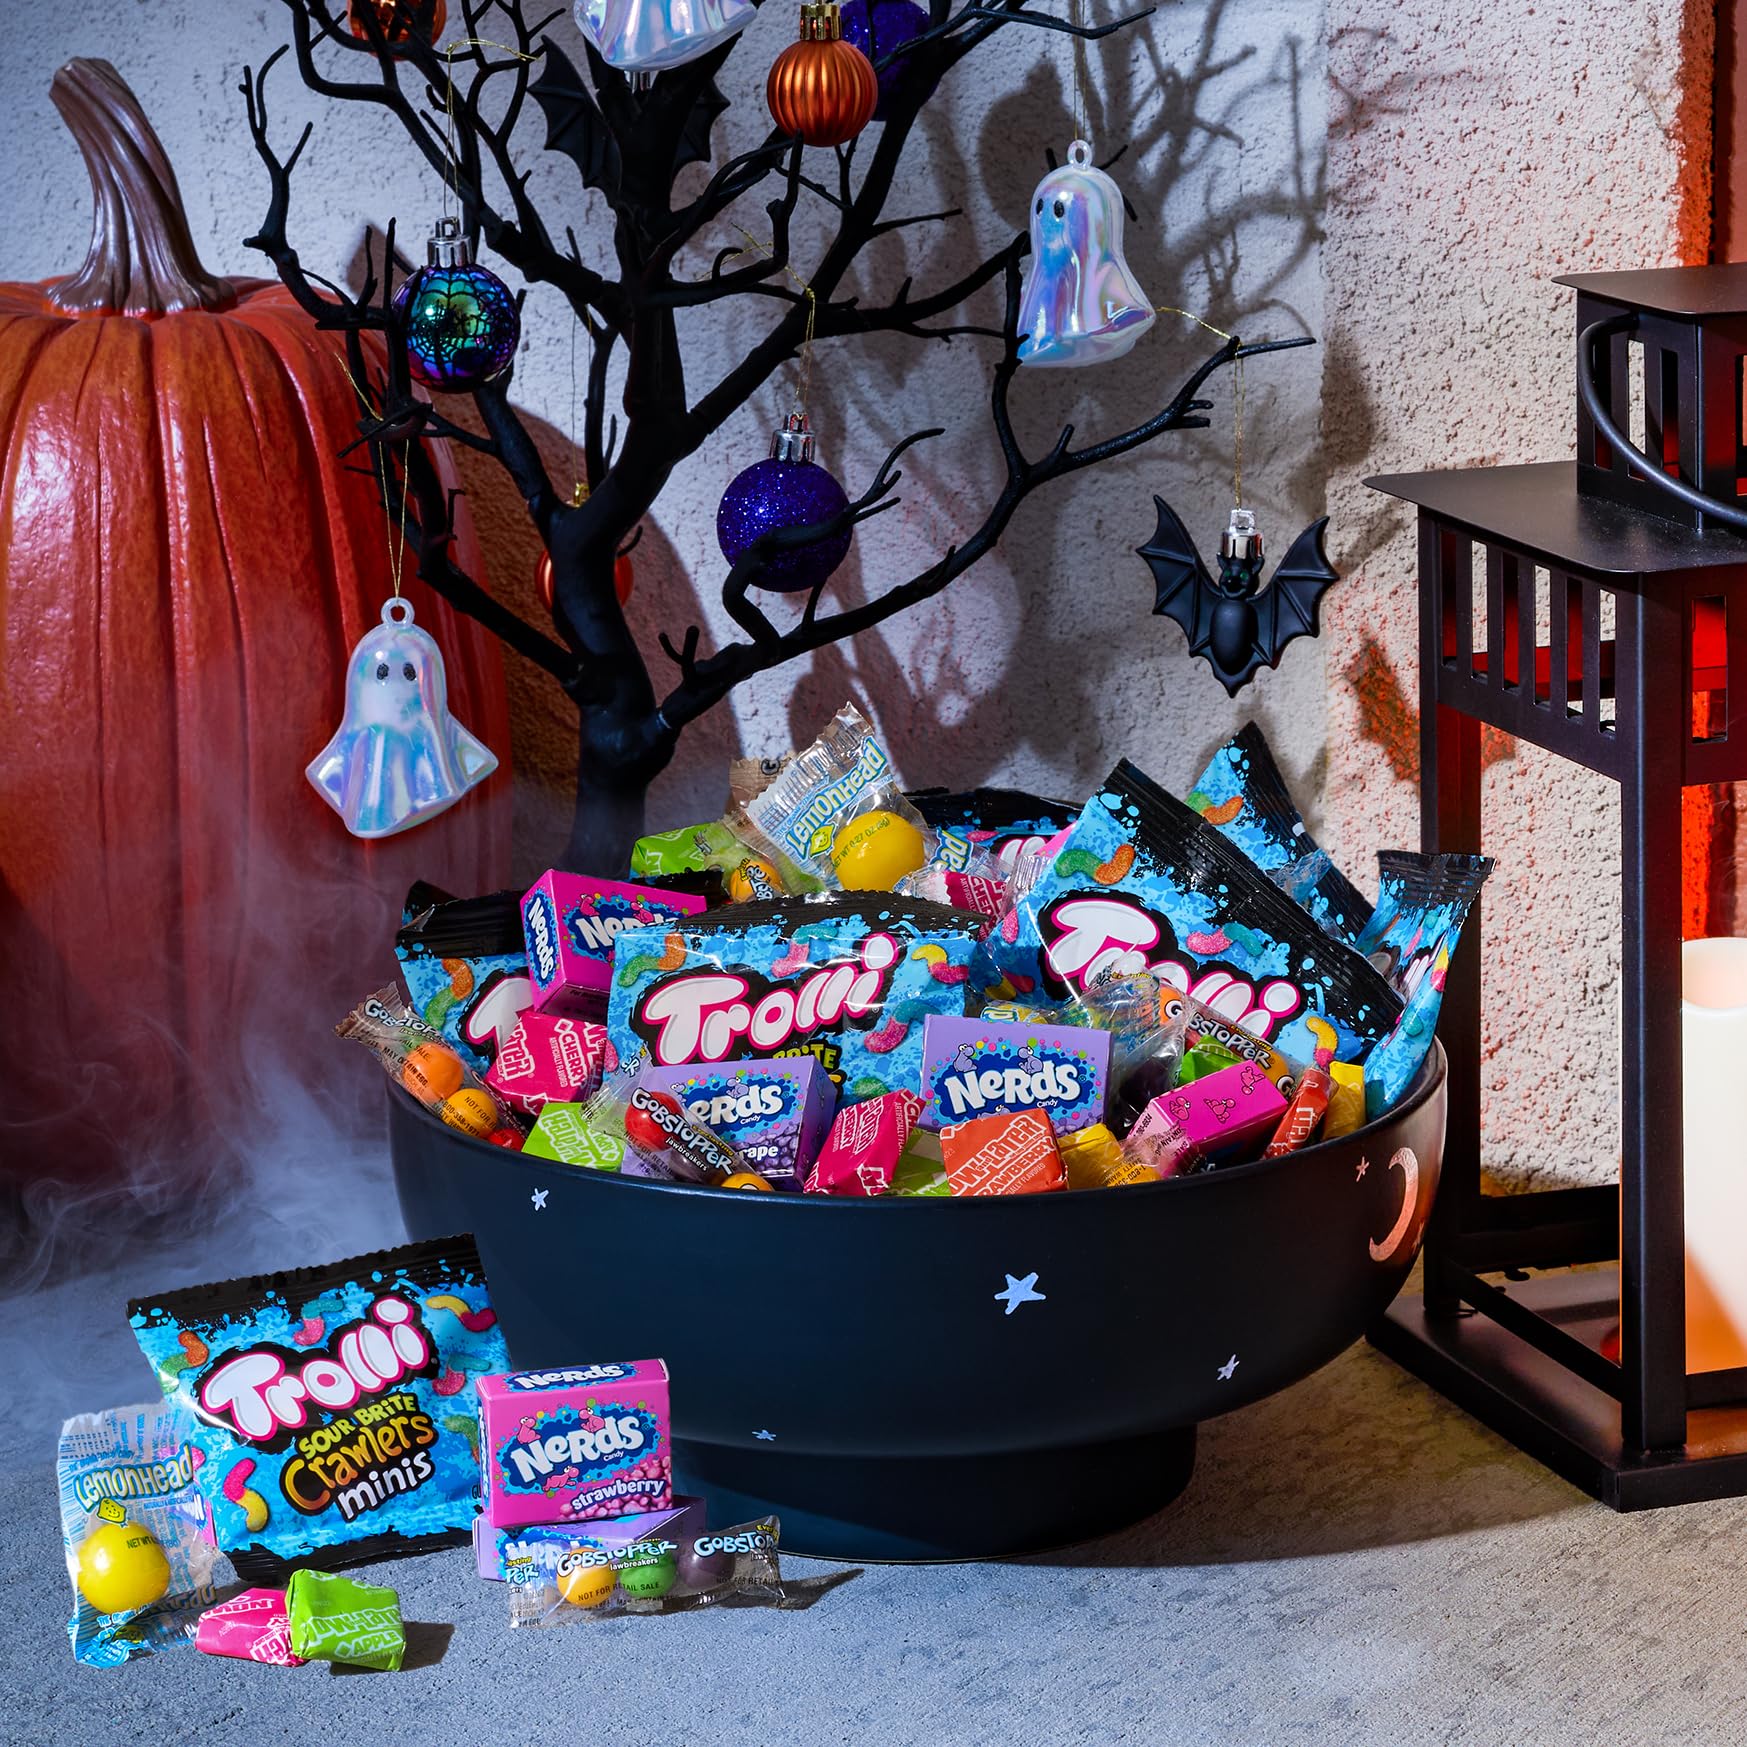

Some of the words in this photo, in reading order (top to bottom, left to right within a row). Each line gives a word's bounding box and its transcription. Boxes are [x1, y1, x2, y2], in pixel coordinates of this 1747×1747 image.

[643, 932, 897, 1066] Trolli
[383, 1045, 398, 1059] MAY
[561, 1031, 588, 1086] CHERRY
[464, 1096, 478, 1110] NOT
[1036, 1097, 1058, 1108] Candy
[740, 1115, 761, 1125] Candy
[665, 1136, 708, 1172] jawbreakers
[205, 1298, 426, 1438] Trolli
[299, 1418, 356, 1460] SOUR
[284, 1415, 434, 1511] Crawlers
[603, 1449, 625, 1462] Candy
[337, 1450, 433, 1519] minis
[571, 1478, 666, 1512] strawberry
[609, 1557, 660, 1572] jawbreakers
[578, 1591, 594, 1602] NOT
[595, 1585, 612, 1597] FOR
[354, 1632, 400, 1652] APPLE
